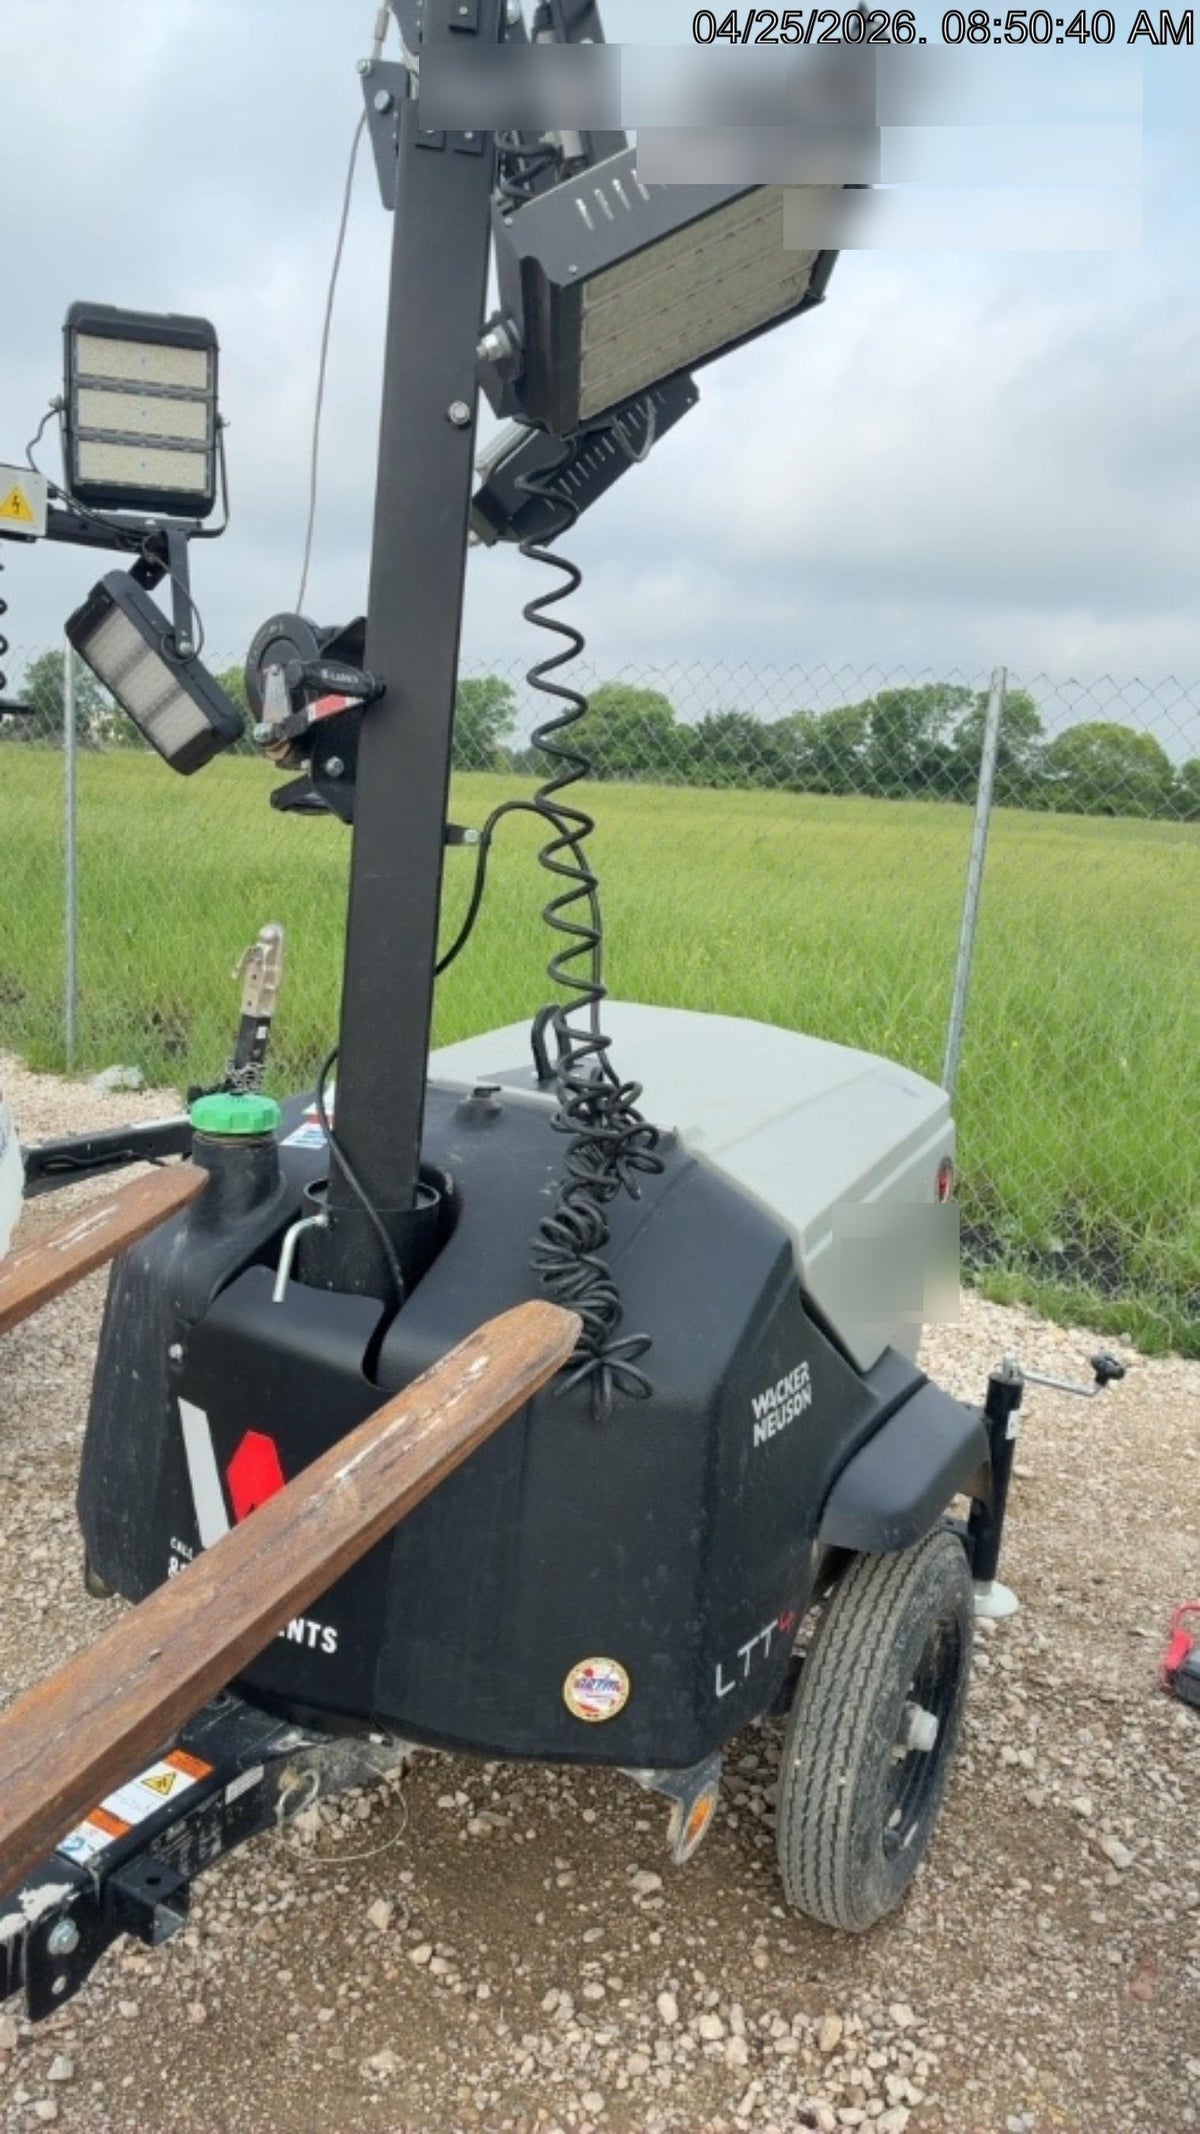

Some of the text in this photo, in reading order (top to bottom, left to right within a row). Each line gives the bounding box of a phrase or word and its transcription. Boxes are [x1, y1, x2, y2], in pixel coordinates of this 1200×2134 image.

[751, 1361, 810, 1419] WACKER
[753, 1383, 812, 1447] NEUSON
[278, 1617, 338, 1653] NTS
